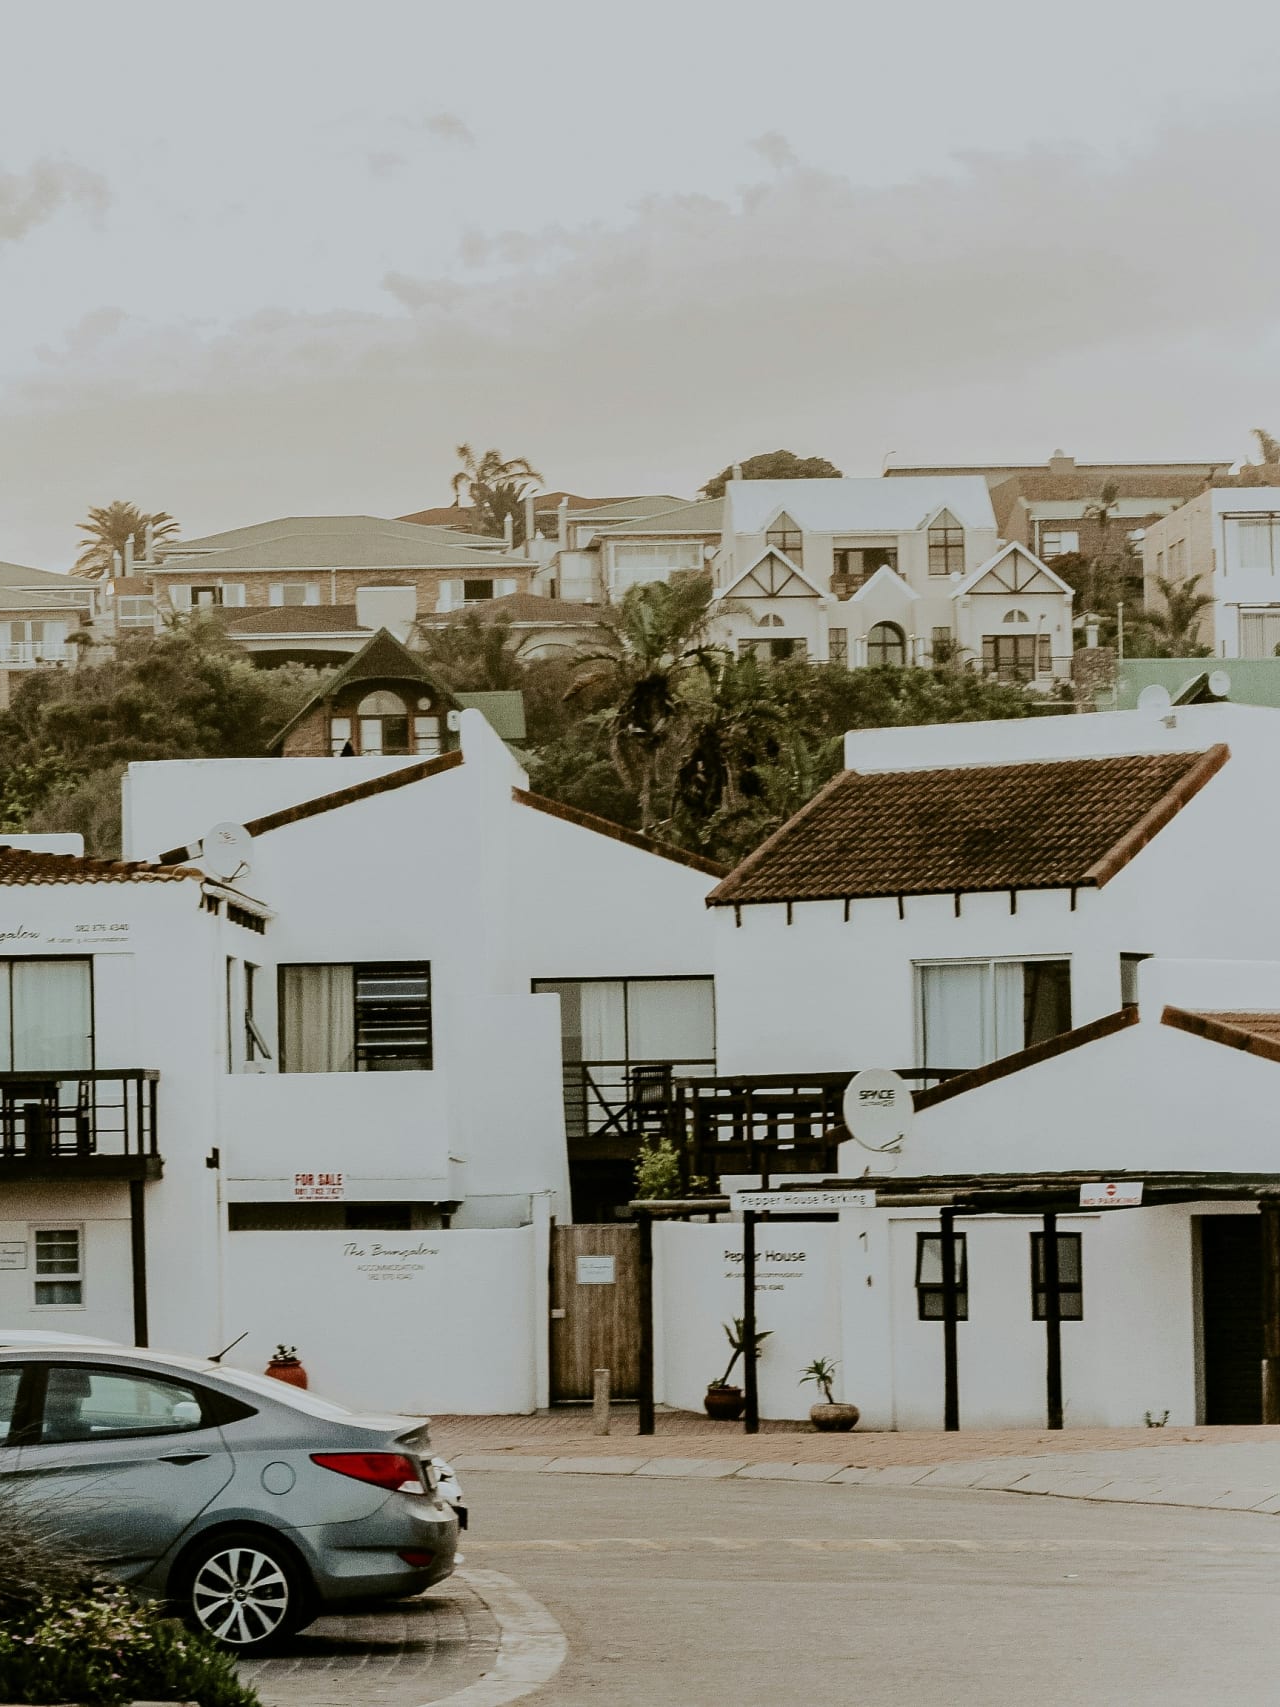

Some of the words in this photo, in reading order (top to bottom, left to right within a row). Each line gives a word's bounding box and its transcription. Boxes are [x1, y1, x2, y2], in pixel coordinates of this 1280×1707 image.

[295, 1173, 314, 1186] FOR
[318, 1173, 342, 1186] SALE
[741, 1195, 781, 1206] Pepper
[785, 1194, 819, 1205] House
[822, 1193, 866, 1205] Parking
[343, 1242, 365, 1256] The
[370, 1242, 439, 1261] Bungalow
[765, 1250, 806, 1262] House
